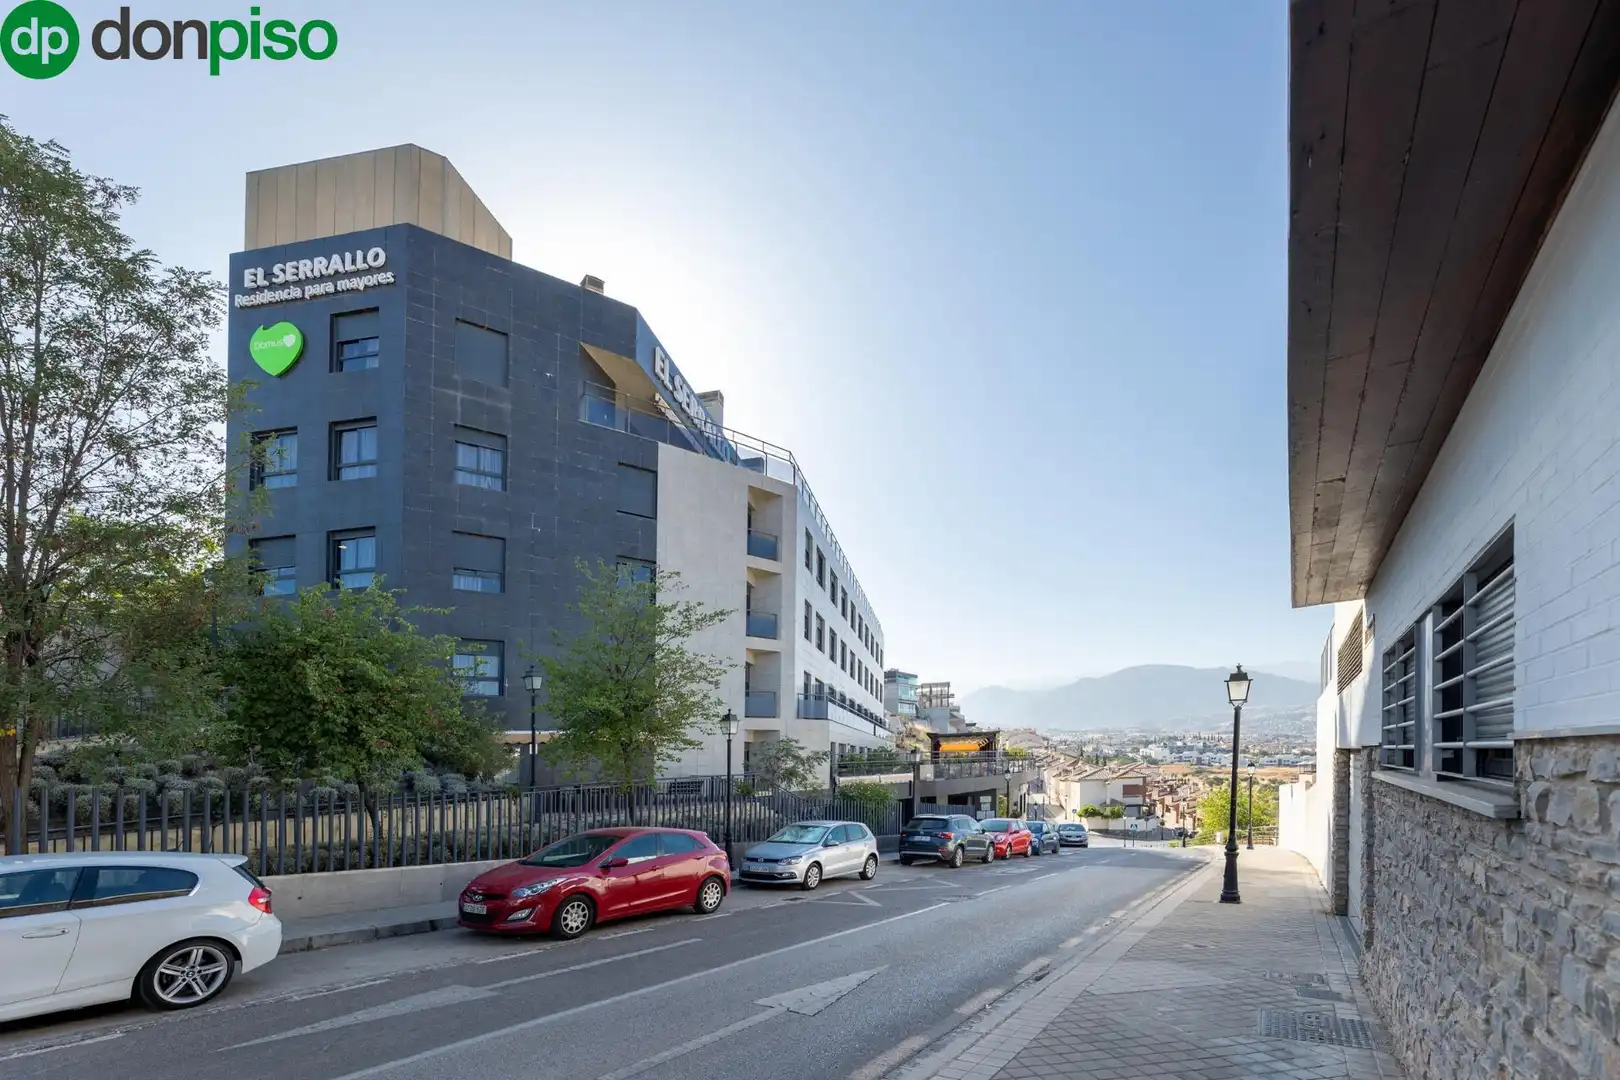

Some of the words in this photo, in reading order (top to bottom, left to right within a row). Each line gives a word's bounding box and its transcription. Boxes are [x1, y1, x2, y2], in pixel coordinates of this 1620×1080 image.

[244, 267, 269, 289] EL
[272, 247, 386, 284] SERRALLO
[234, 286, 302, 308] Residencia
[304, 281, 335, 299] para
[337, 271, 395, 291] mayores
[654, 346, 673, 392] EL
